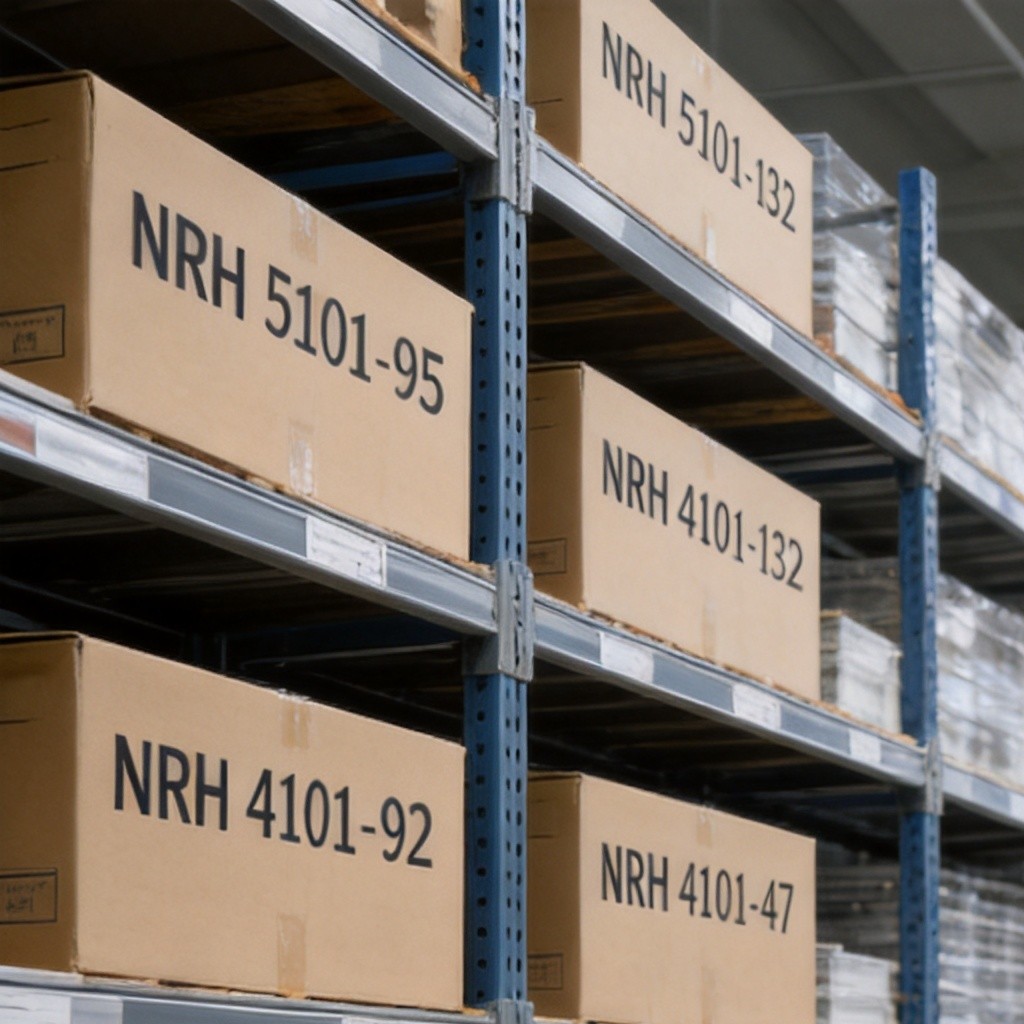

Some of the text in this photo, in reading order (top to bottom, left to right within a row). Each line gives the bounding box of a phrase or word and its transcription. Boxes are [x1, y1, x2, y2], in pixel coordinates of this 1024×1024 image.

[602, 21, 796, 233] NRH 5101-132
[132, 190, 444, 415] NRH 5101-95
[602, 439, 803, 591] NRH 4101-132
[113, 733, 433, 869] NRH 4101-92
[601, 842, 794, 934] NRH 4101-47
